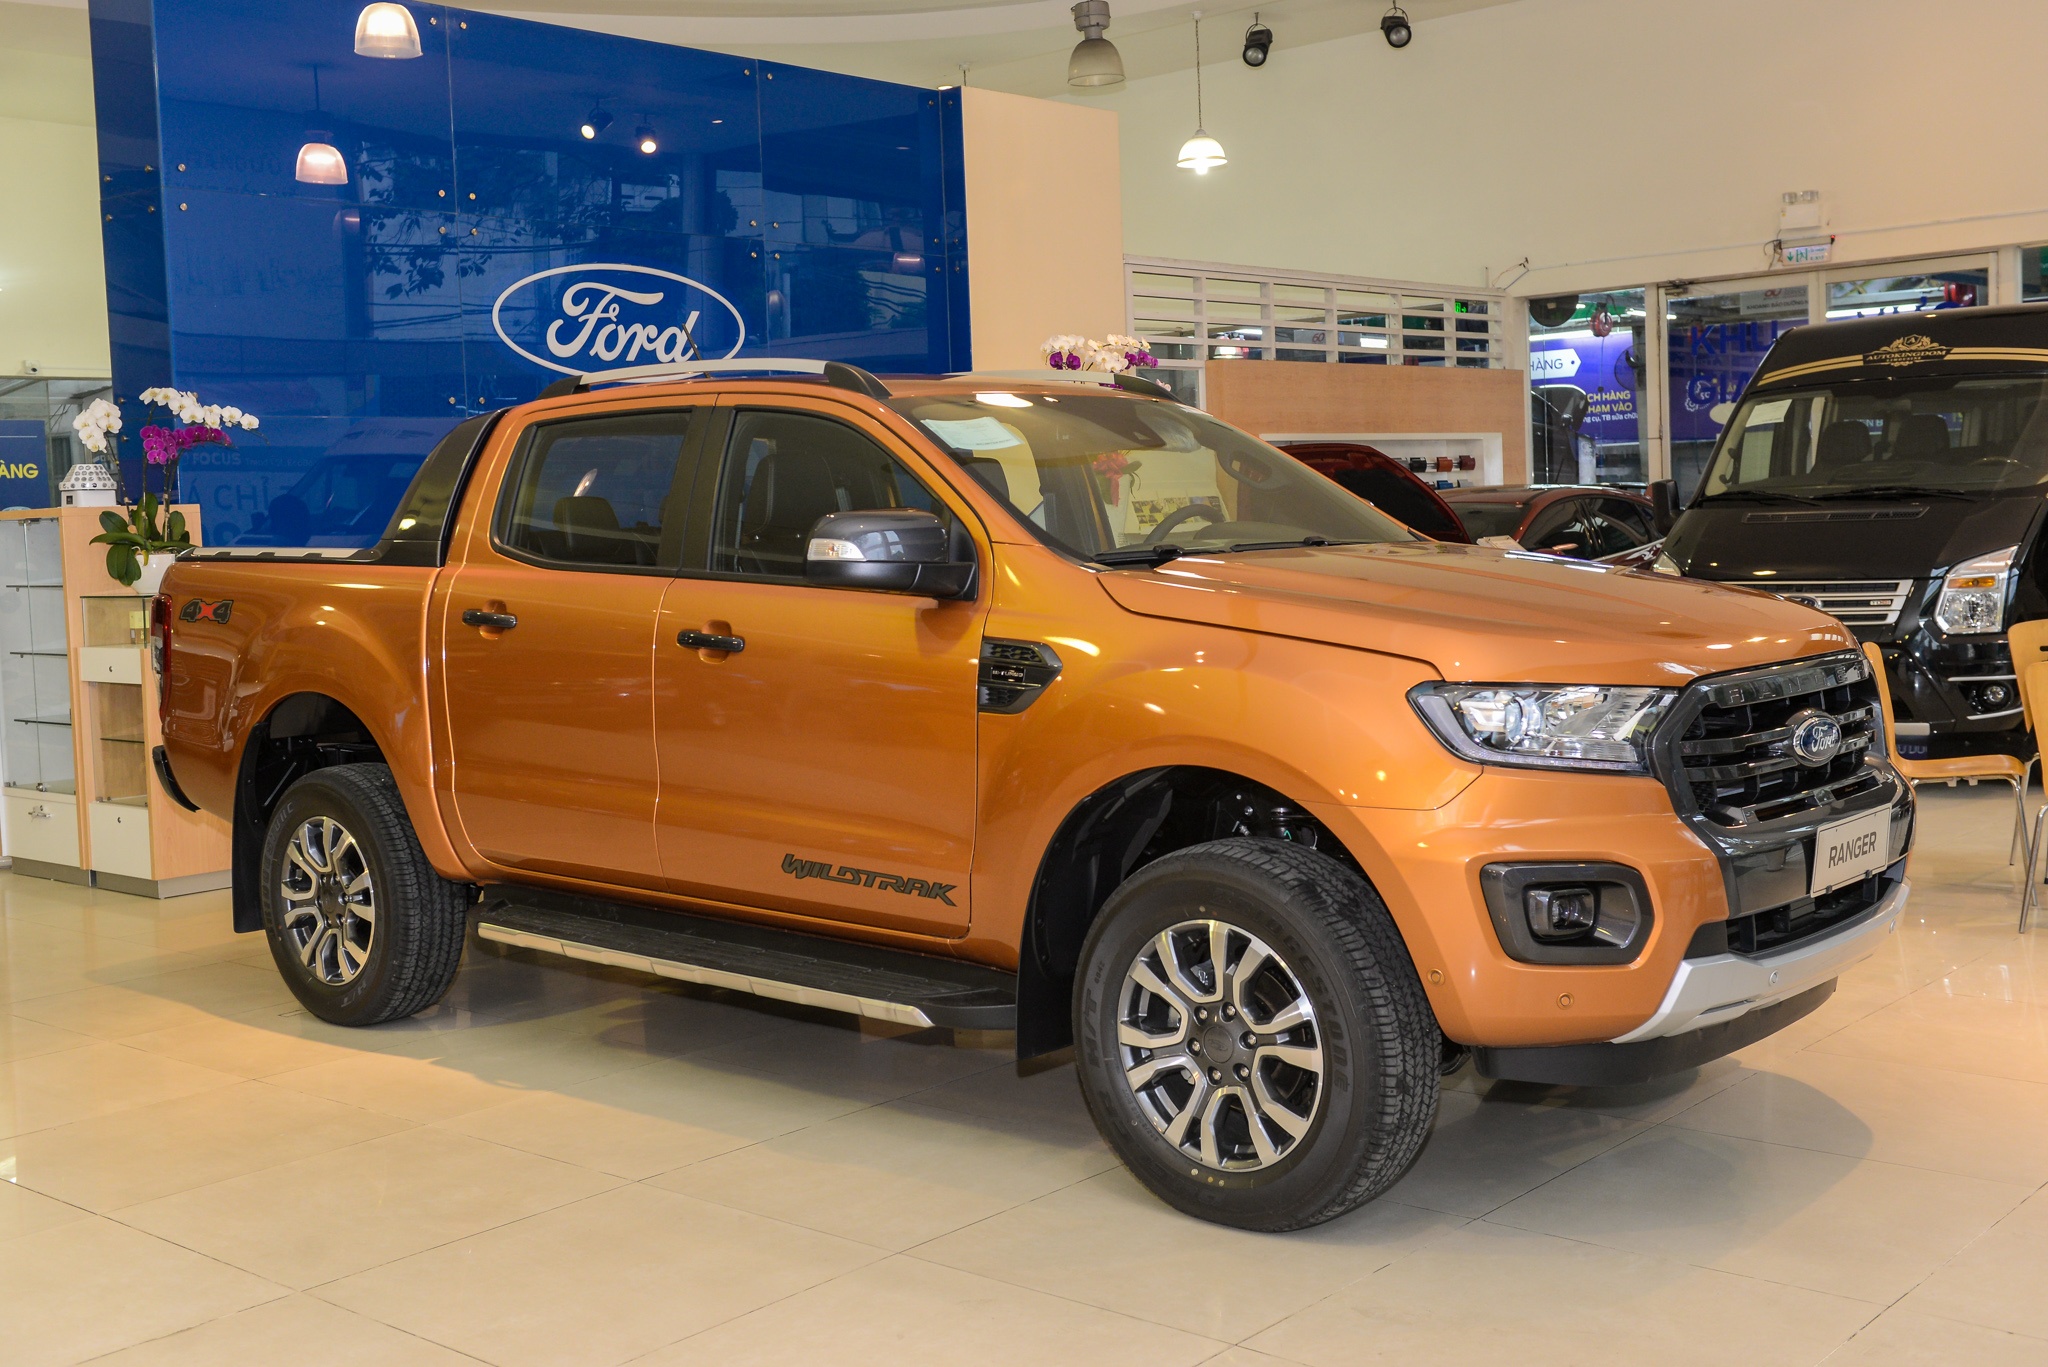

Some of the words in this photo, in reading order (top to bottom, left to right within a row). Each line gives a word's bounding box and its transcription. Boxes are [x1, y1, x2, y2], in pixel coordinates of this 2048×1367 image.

[546, 282, 700, 363] Ford
[1691, 320, 1778, 356] KHU
[1866, 350, 1947, 361] AUTOKINGDOM
[1587, 392, 1601, 403] CH
[1602, 389, 1631, 401] HÀNG
[1587, 404, 1610, 415] HẠM
[1612, 401, 1633, 412] VÀO
[192, 452, 240, 466] FOCUS
[1811, 725, 1838, 752] Ford
[1828, 831, 1877, 869] RANGER
[781, 853, 958, 908] WILDTRAK
